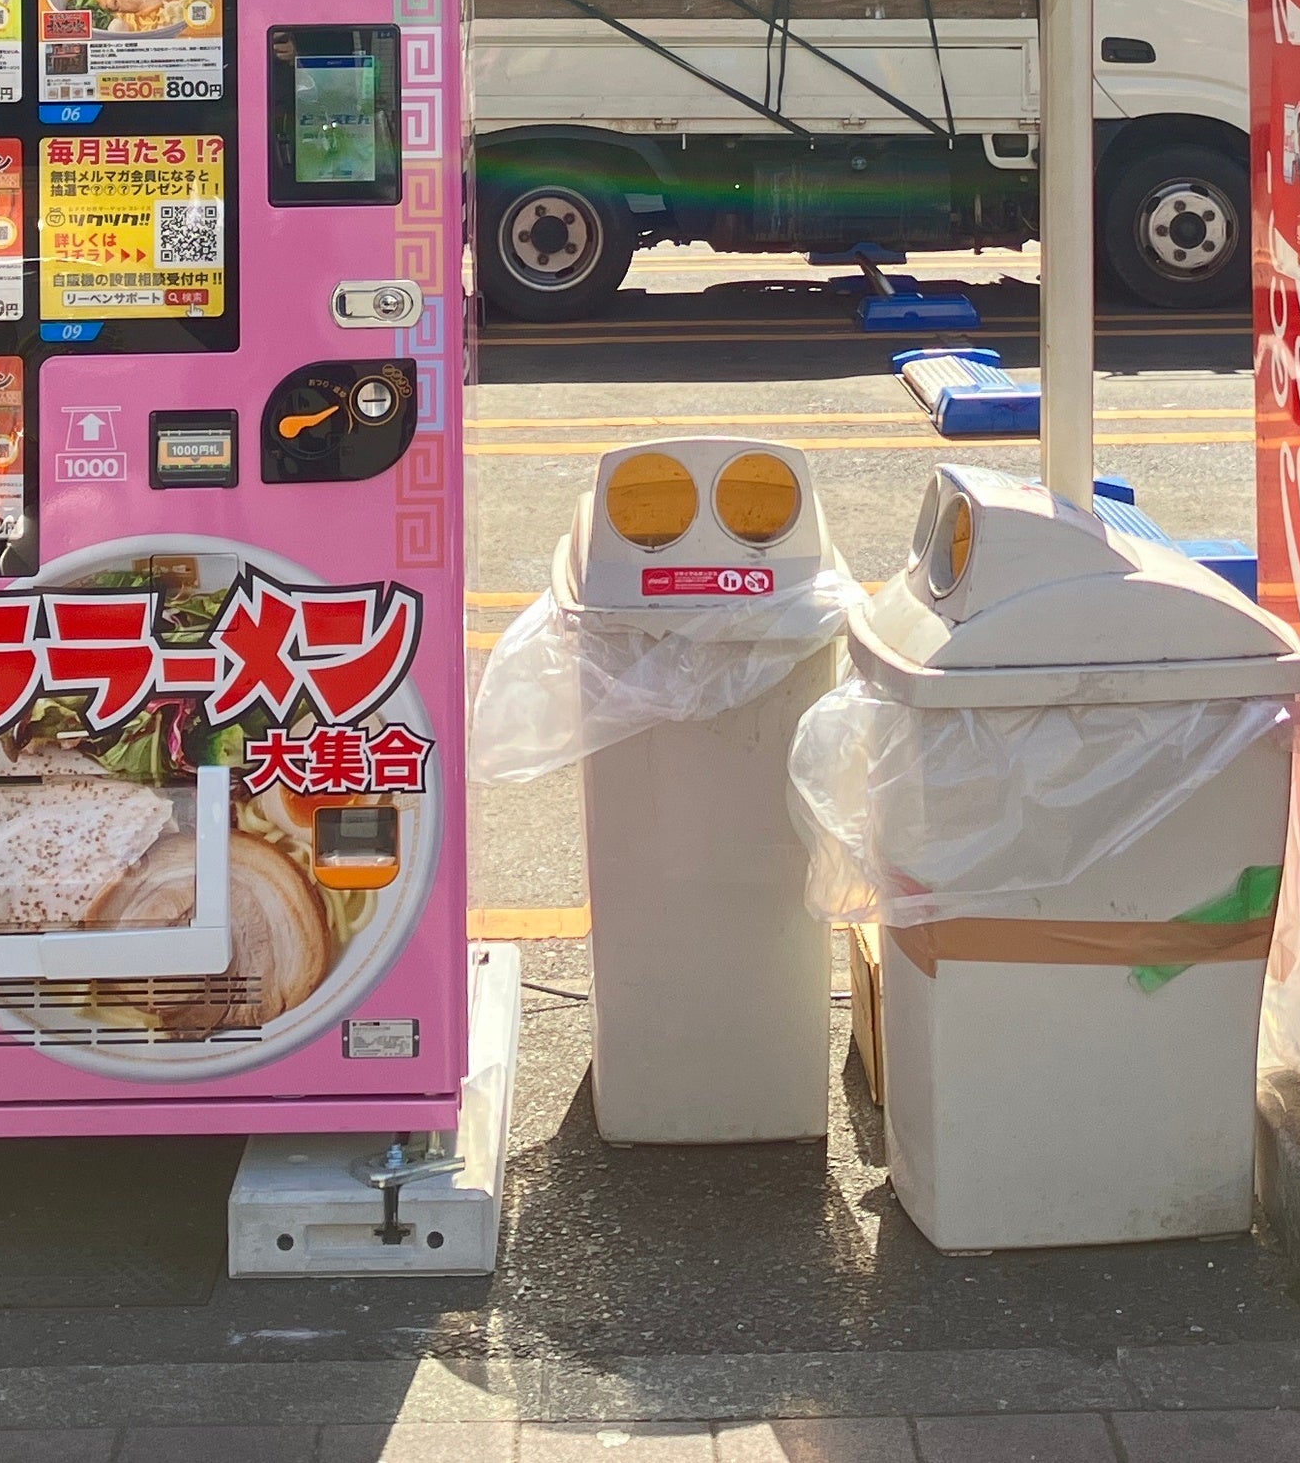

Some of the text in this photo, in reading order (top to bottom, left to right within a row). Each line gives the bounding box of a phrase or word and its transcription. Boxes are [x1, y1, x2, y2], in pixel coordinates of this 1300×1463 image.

[113, 81, 221, 99] 650円 800円
[61, 107, 81, 121] 06
[51, 170, 209, 183] 無料メルマガ会員になると
[54, 233, 117, 247] 詳しくは
[66, 293, 161, 303] リーベンサポート
[62, 325, 82, 339] 09
[171, 444, 220, 456] 1000円札
[65, 459, 119, 478] 1000
[246, 725, 431, 793] 大集合
